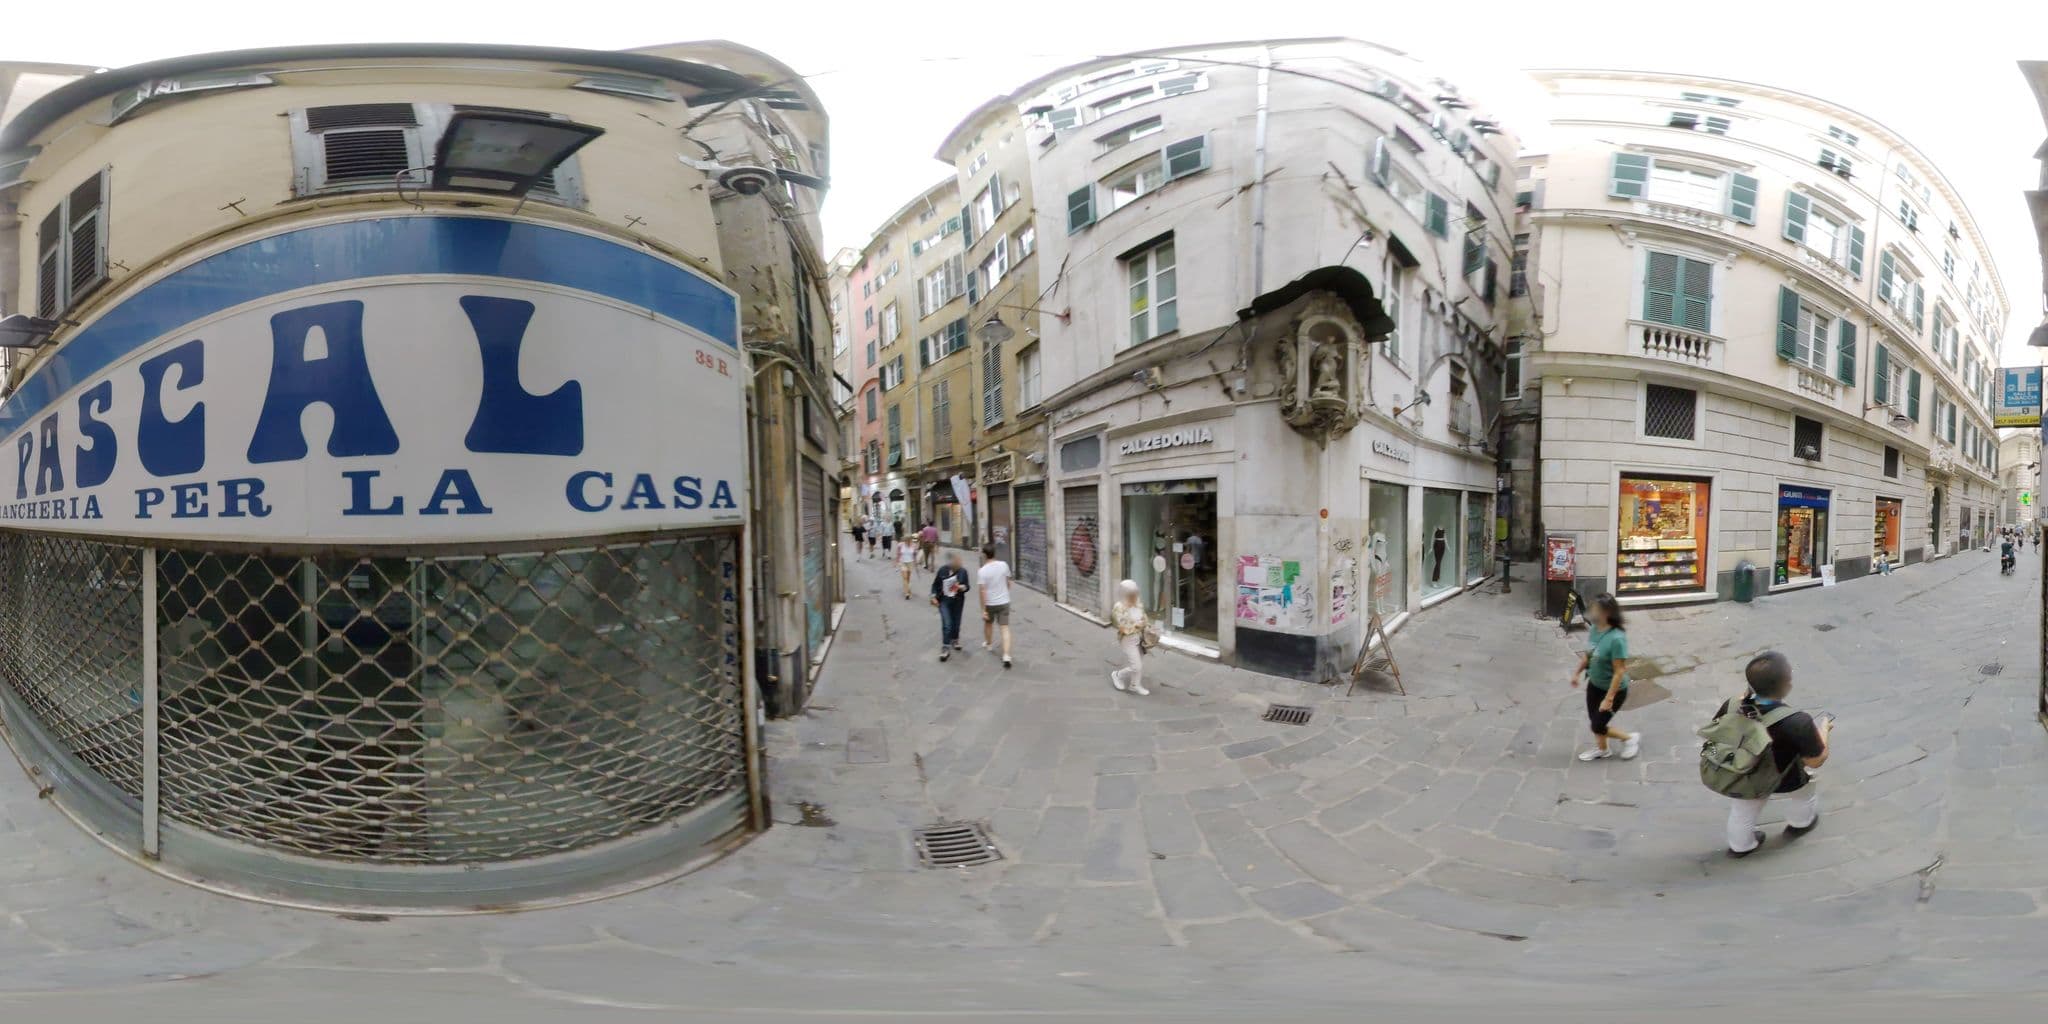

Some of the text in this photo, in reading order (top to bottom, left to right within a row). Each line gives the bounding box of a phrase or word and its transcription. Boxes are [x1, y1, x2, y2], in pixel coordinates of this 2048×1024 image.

[17, 296, 584, 499] PASCAL
[1120, 428, 1213, 455] CALZEDONIA
[135, 478, 272, 519] PER
[343, 470, 492, 517] LA
[566, 471, 737, 513] CASA
